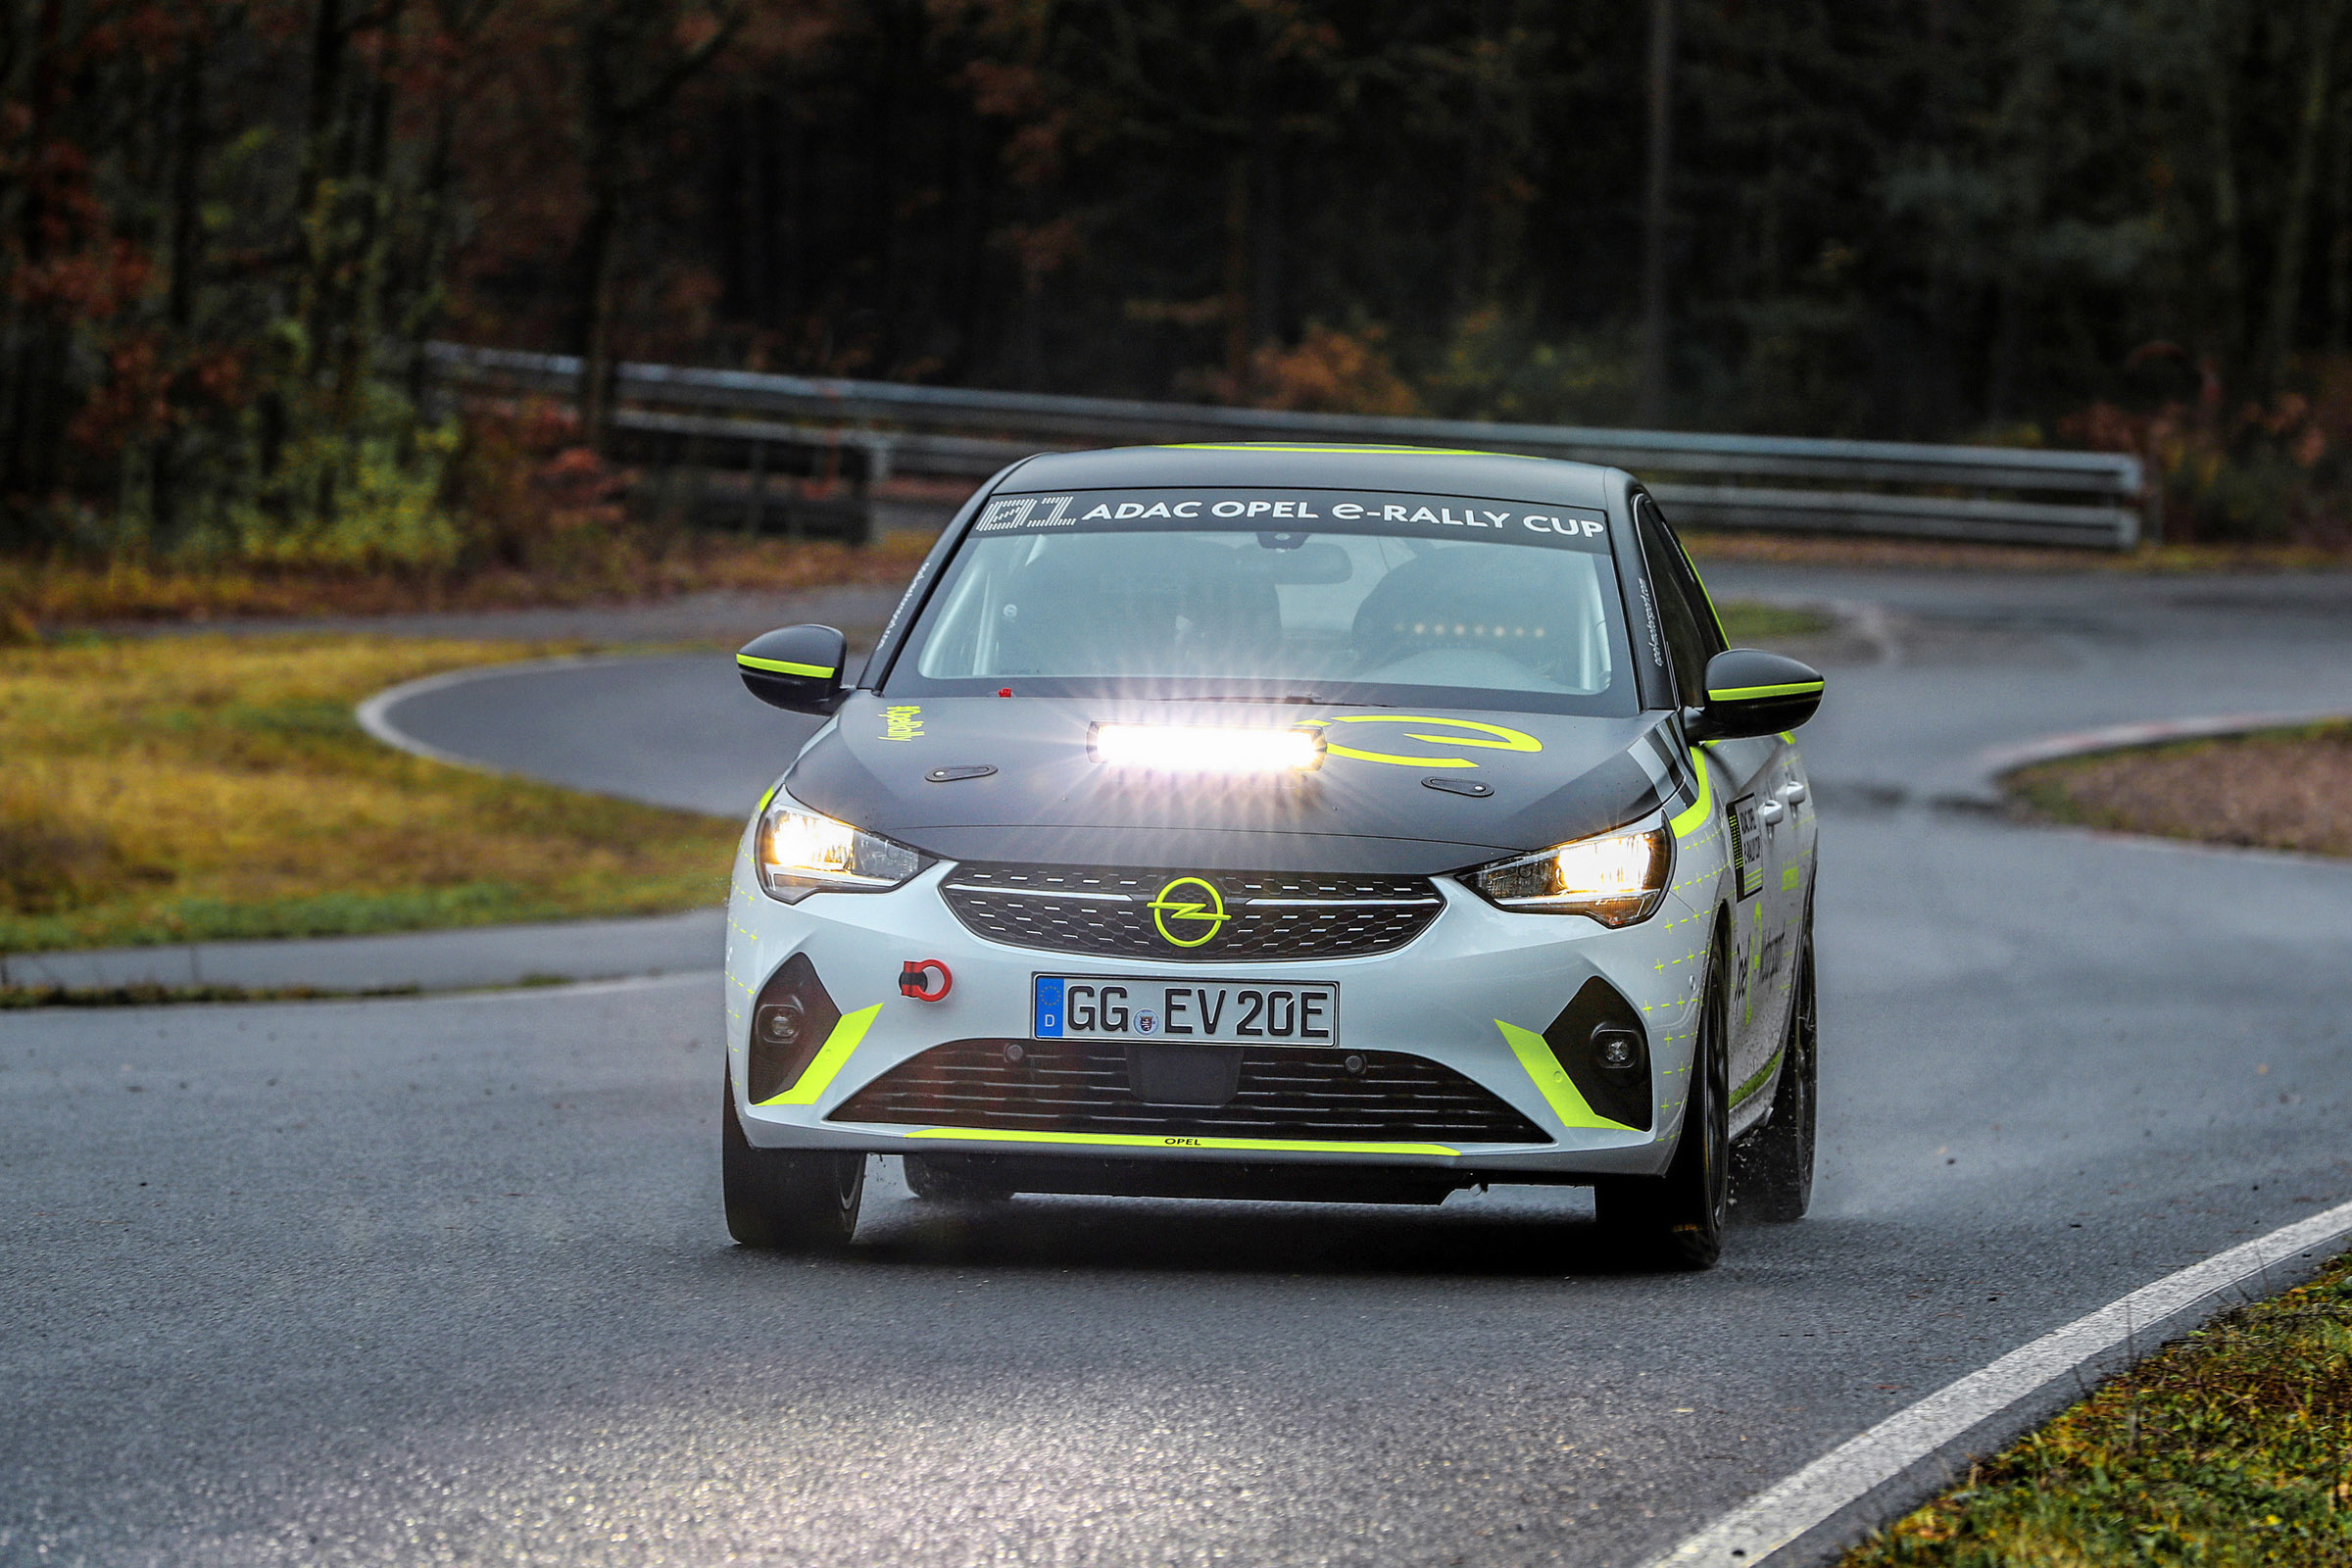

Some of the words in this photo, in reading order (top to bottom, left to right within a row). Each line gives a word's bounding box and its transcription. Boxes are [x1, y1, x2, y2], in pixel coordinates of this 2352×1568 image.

[1081, 501, 1202, 521] ADAC
[1210, 500, 1319, 519] OPEL
[1331, 502, 1511, 529] e-RALLY
[1522, 514, 1605, 539] CUP
[1044, 1013, 1055, 1028] D
[1066, 985, 1129, 1033] GG
[1163, 987, 1227, 1035] EV
[1235, 989, 1330, 1039] 20E
[1164, 1137, 1201, 1147] OPEL
